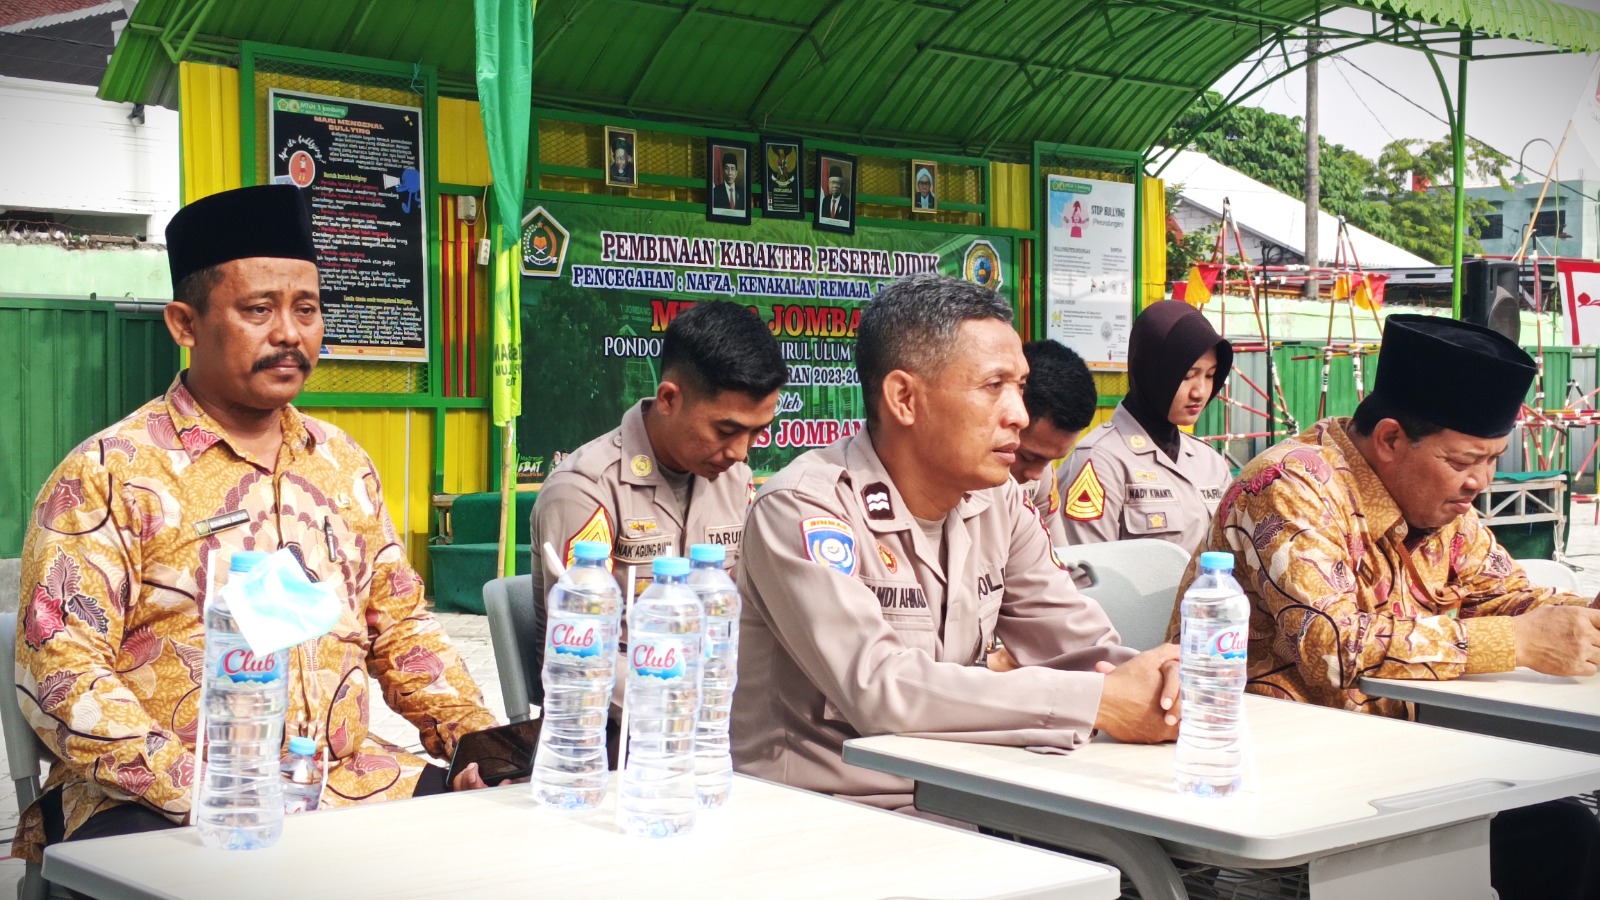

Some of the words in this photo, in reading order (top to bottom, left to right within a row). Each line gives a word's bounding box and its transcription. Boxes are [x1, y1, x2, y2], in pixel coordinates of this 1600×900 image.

[313, 115, 336, 125] MARI
[337, 118, 384, 130] MENGENAL
[328, 124, 371, 135] BULLYING
[1091, 205, 1103, 215] STOP
[1104, 206, 1125, 218] BULLYING
[602, 232, 714, 266] PEMBINAAN
[720, 240, 813, 272] KARAKTER
[817, 248, 891, 276] PESERTA
[573, 265, 675, 290] PENCEGAHAN
[686, 272, 735, 295] NAFZA,
[739, 275, 817, 298] KENAKALAN
[814, 339, 850, 361] ULUM
[551, 623, 594, 647] Club
[223, 648, 276, 675] Club
[633, 644, 676, 669] Club
